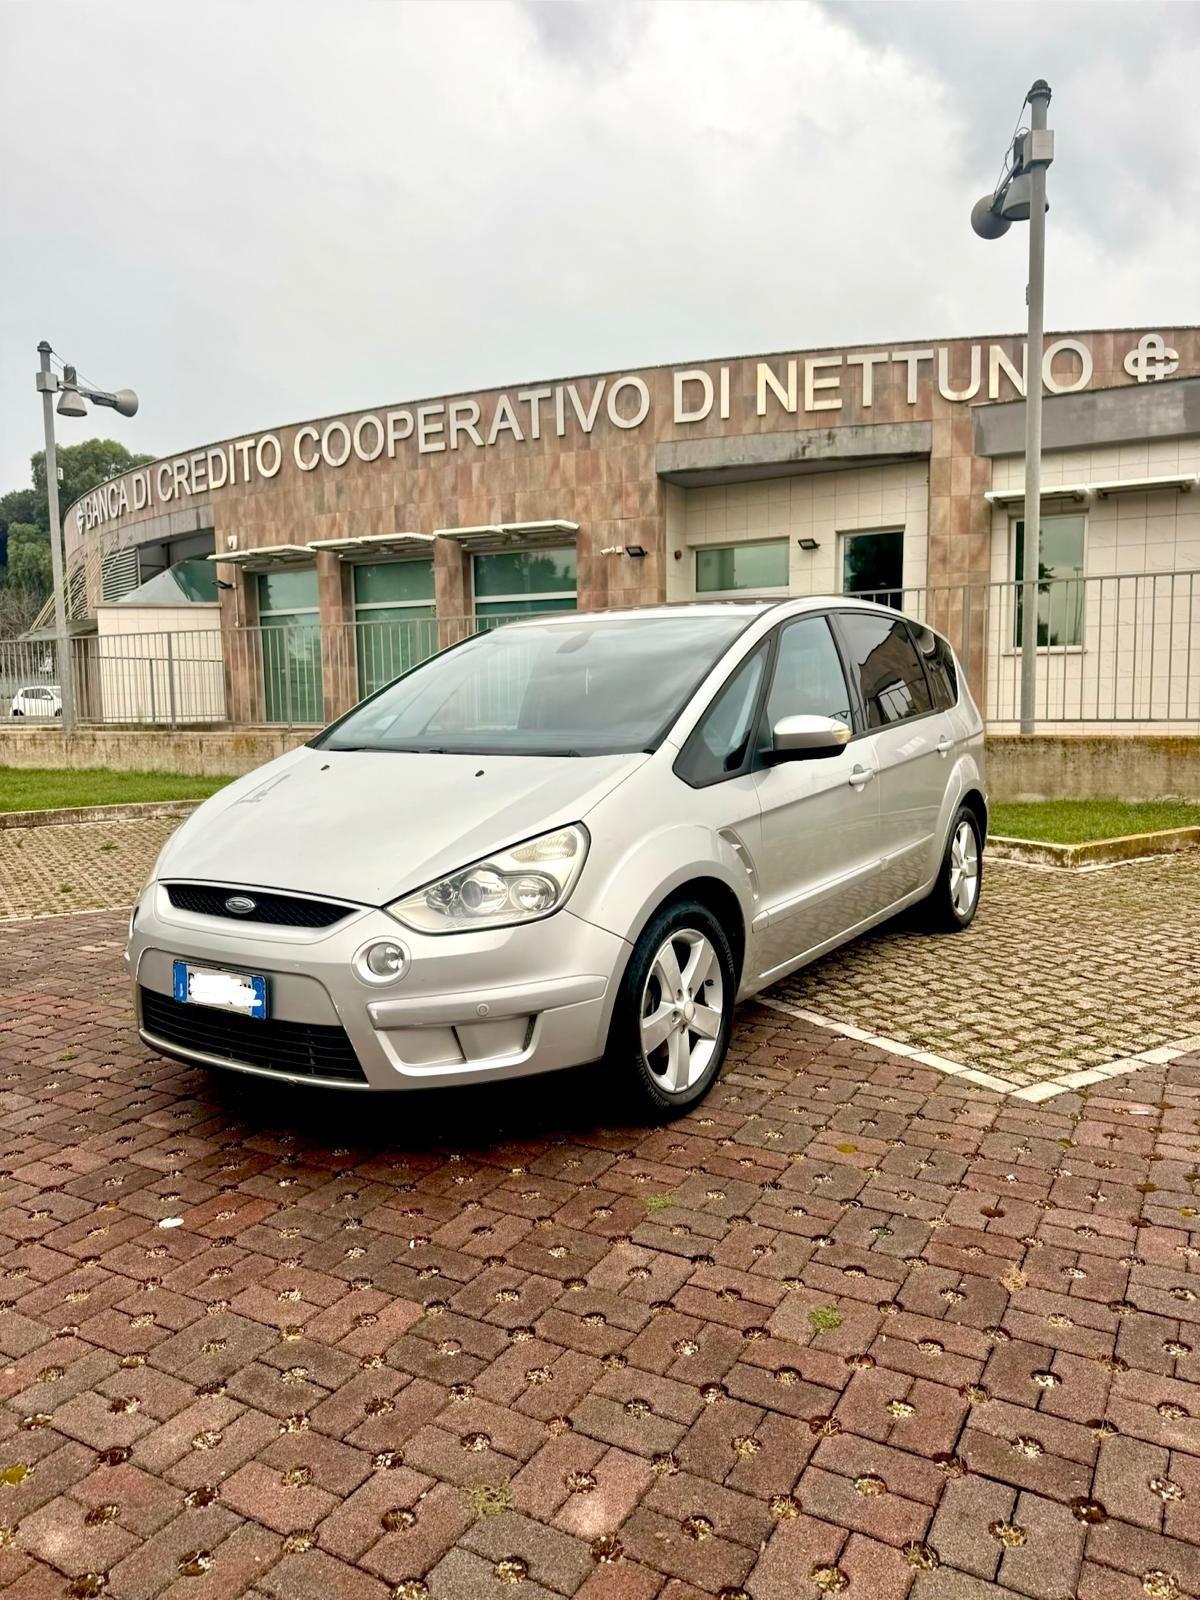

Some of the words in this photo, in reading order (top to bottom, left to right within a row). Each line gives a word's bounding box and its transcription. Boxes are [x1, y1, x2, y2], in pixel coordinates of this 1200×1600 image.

[85, 479, 130, 530] BANCA
[132, 469, 153, 510] DI
[157, 434, 282, 502] CREDITO
[293, 375, 651, 471] COOPERATIVO
[673, 366, 730, 424] DI
[756, 339, 1093, 416] NETTUNO
